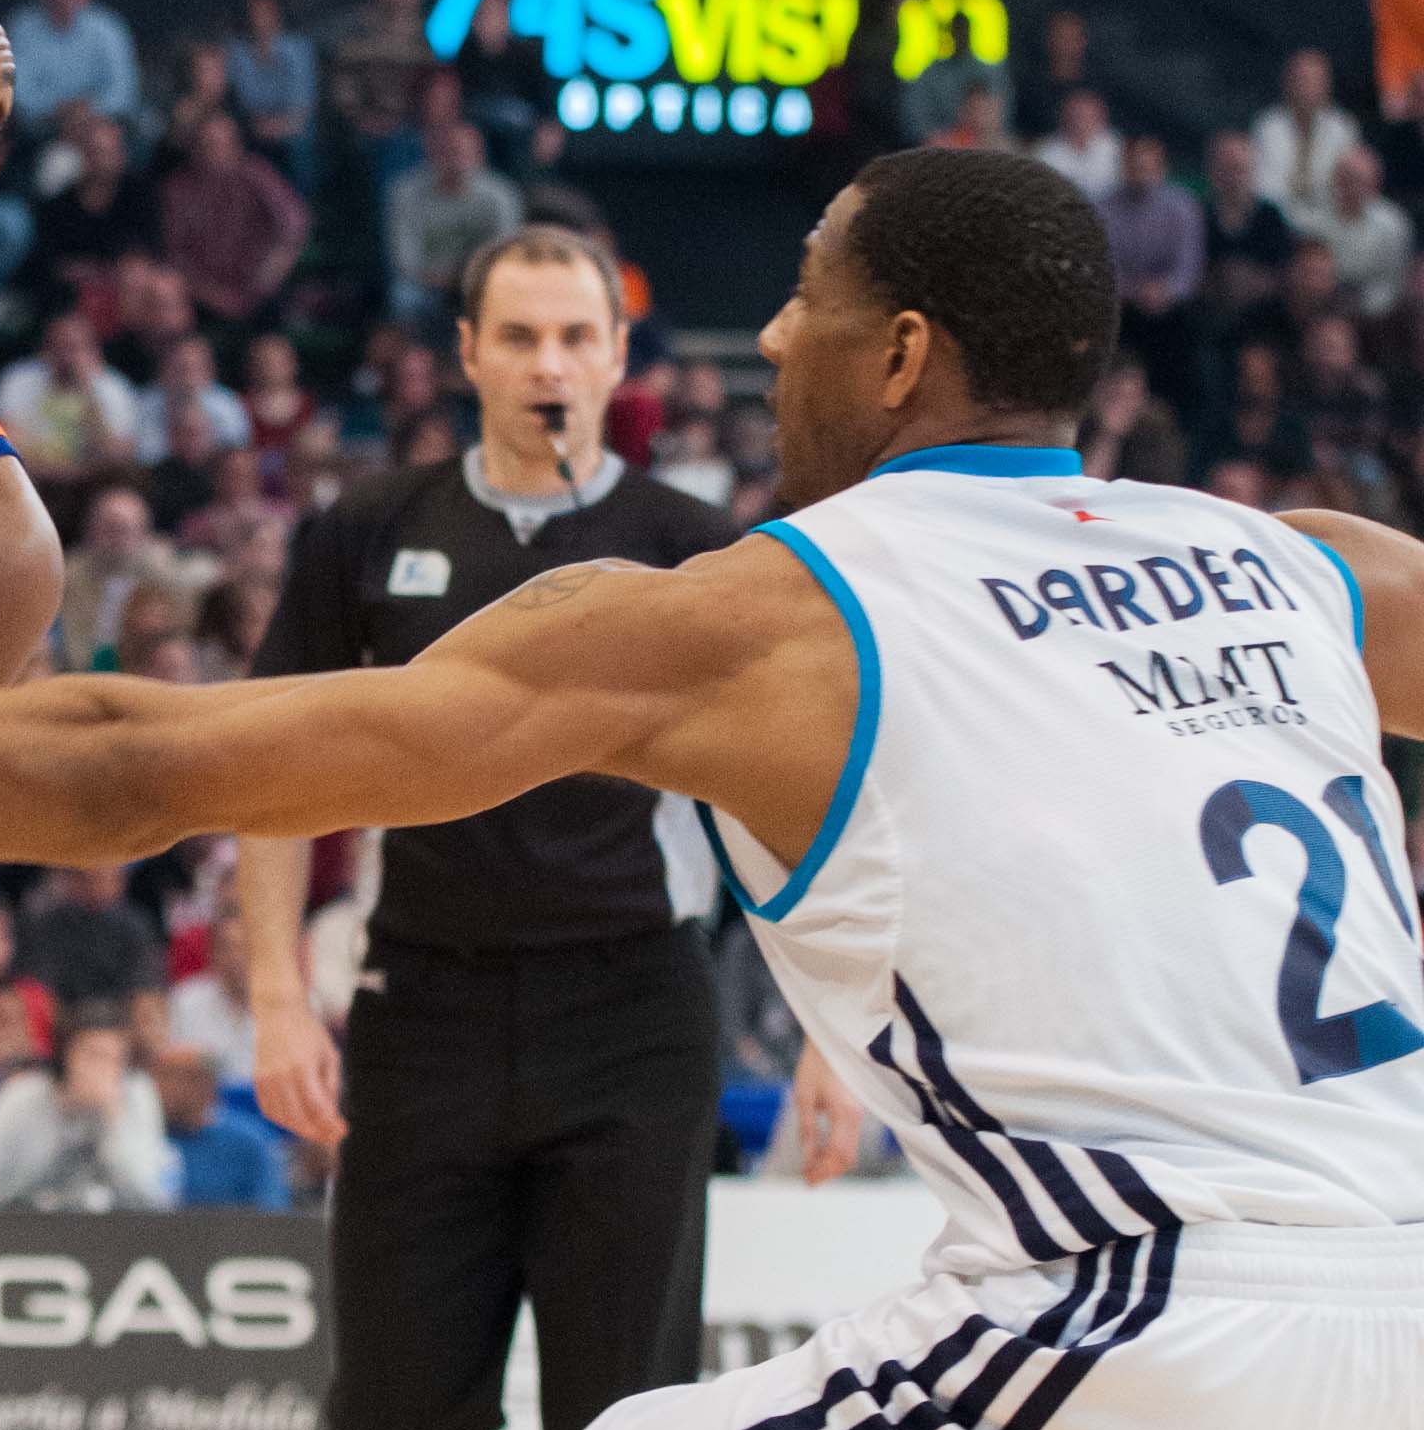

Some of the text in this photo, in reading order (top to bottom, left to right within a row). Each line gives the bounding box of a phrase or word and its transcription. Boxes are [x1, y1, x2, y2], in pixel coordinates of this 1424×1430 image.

[979, 545, 1299, 641] DARDEN
[1097, 641, 1295, 715] MMT
[1165, 704, 1309, 737] SEGUROS
